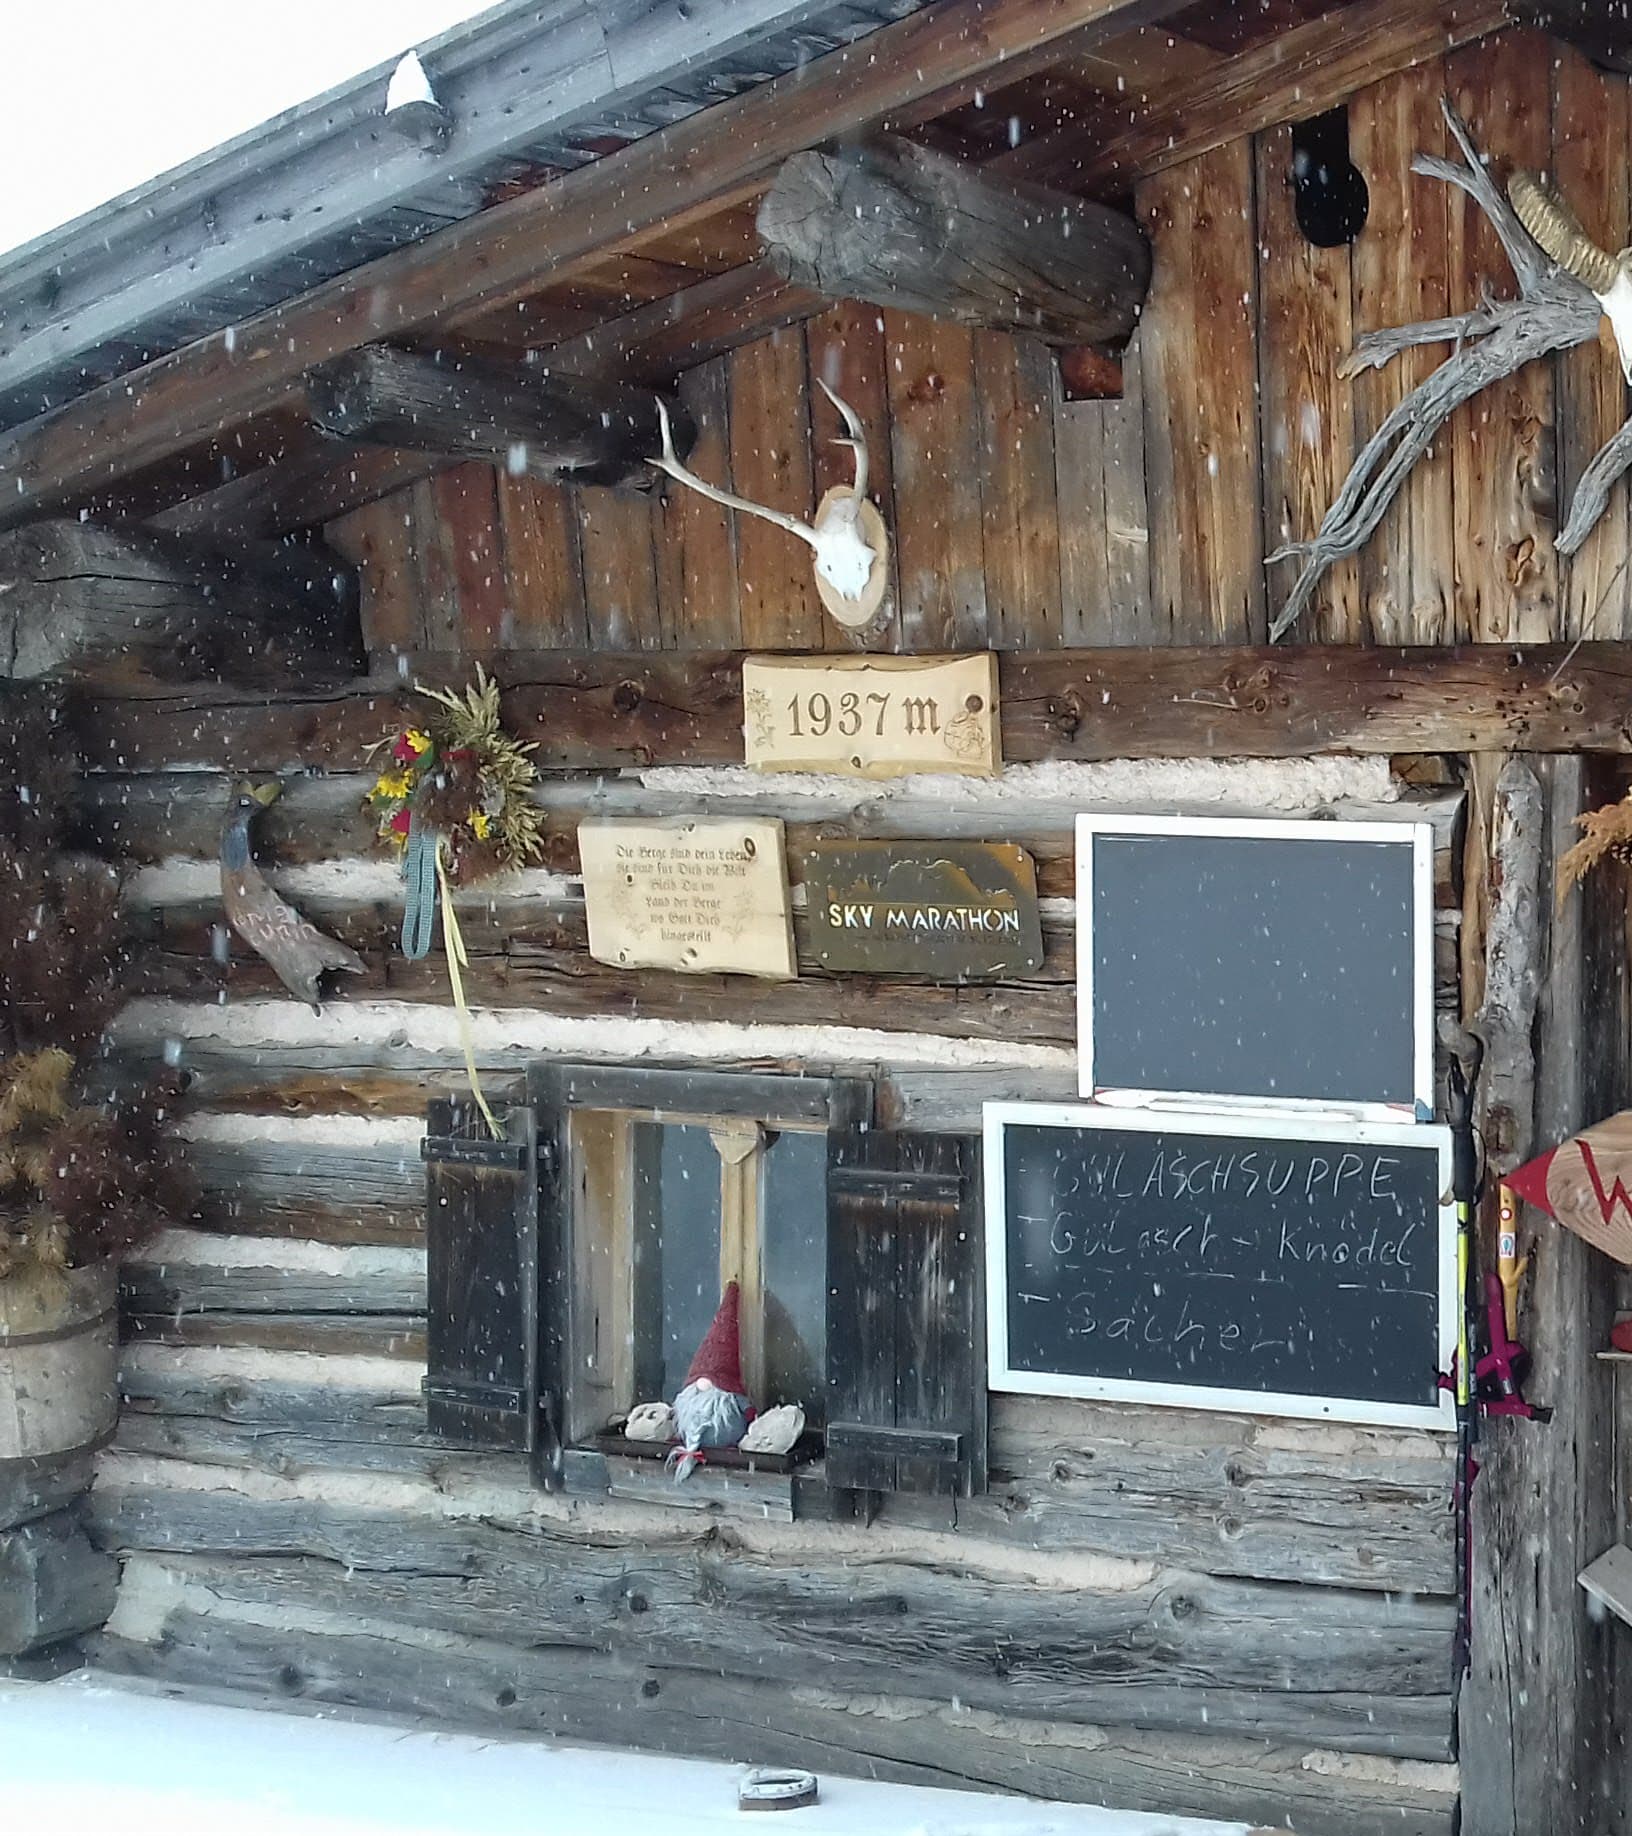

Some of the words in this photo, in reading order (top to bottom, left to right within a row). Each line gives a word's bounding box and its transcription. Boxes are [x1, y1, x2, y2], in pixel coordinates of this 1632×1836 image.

[786, 691, 893, 738] 1937
[902, 694, 942, 735] m
[829, 903, 873, 929] SKY
[886, 907, 1020, 932] MARATHON
